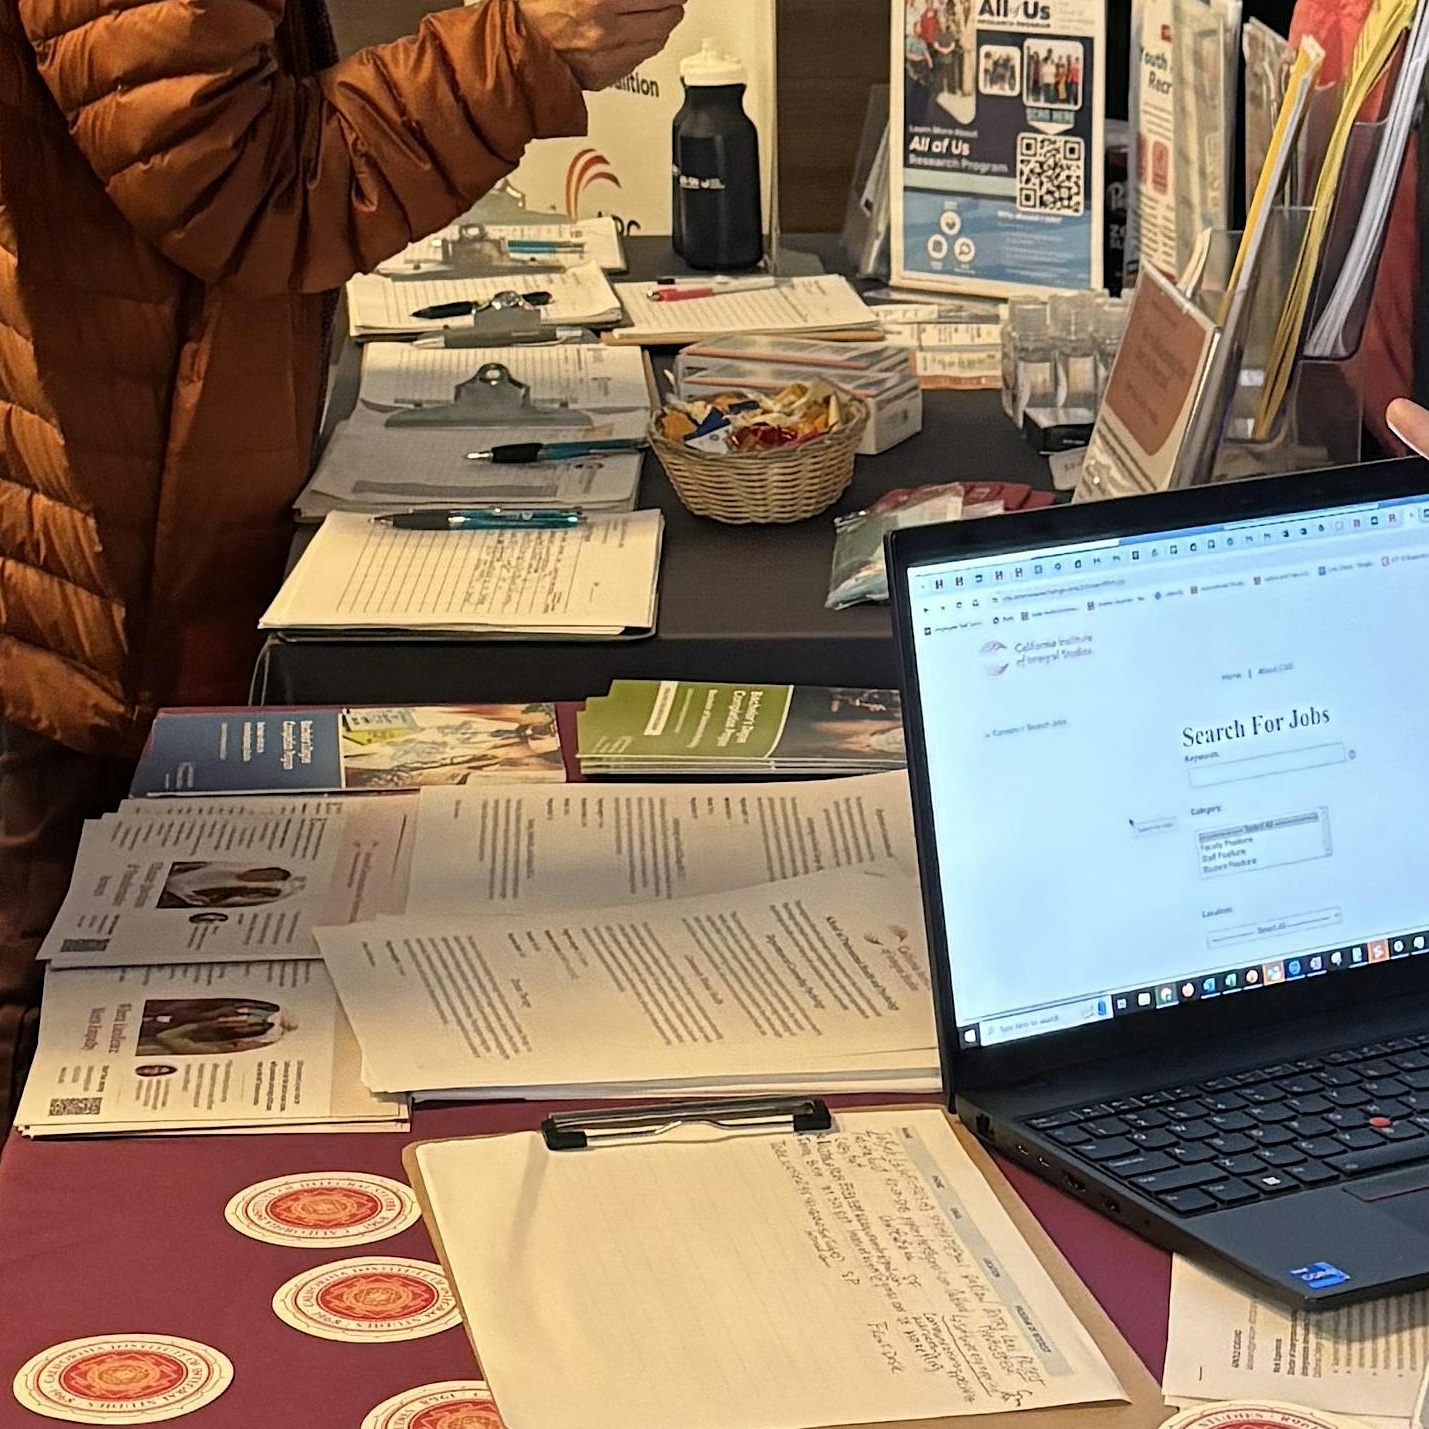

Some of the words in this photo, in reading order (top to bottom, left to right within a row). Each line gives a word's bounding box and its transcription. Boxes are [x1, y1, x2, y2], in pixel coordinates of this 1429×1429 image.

[1022, 1, 1051, 20] Us
[909, 136, 929, 152] All
[933, 138, 949, 153] of
[951, 140, 970, 156] Us
[909, 154, 959, 169] Research
[961, 157, 1008, 173] Program
[1182, 719, 1246, 748] Search
[1252, 714, 1285, 736] For
[1289, 706, 1331, 730] Jobs
